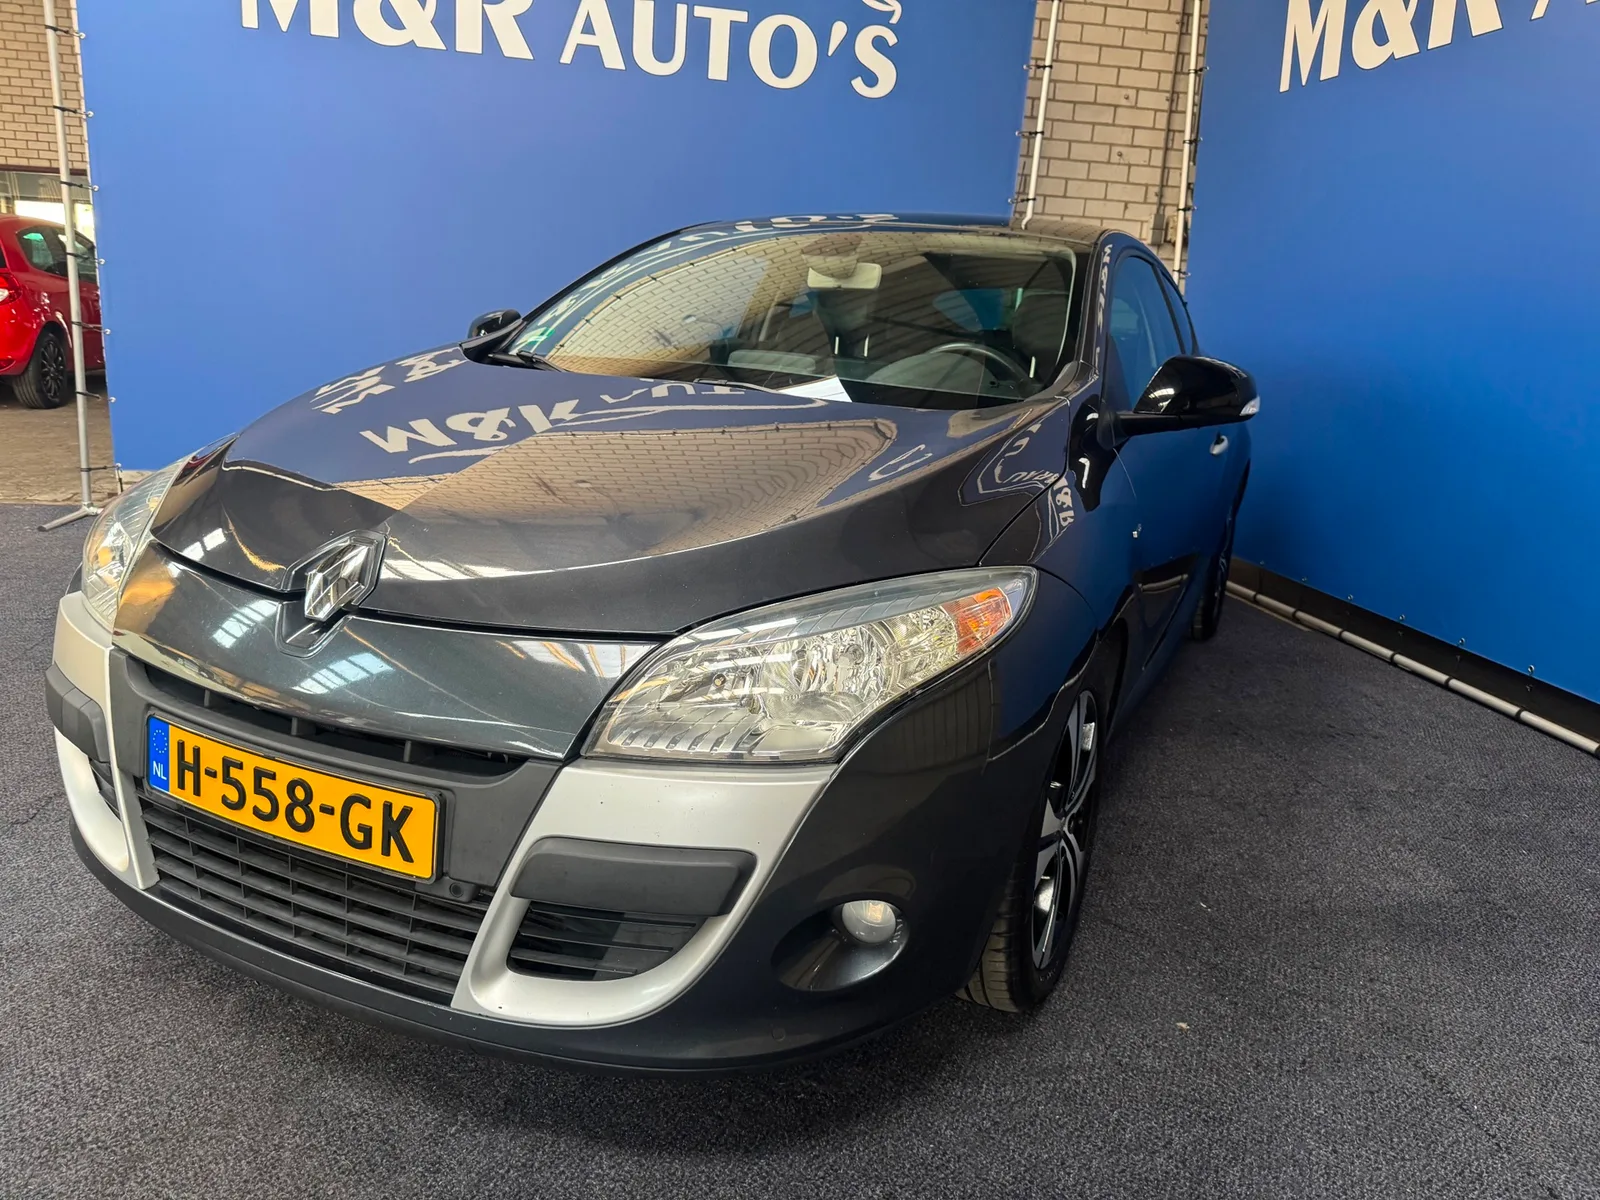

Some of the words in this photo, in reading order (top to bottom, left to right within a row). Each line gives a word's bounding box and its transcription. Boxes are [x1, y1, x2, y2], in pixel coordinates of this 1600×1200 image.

[559, 0, 899, 99] AUTO'S
[152, 760, 168, 781] NL
[177, 739, 415, 863] H-558-GK
